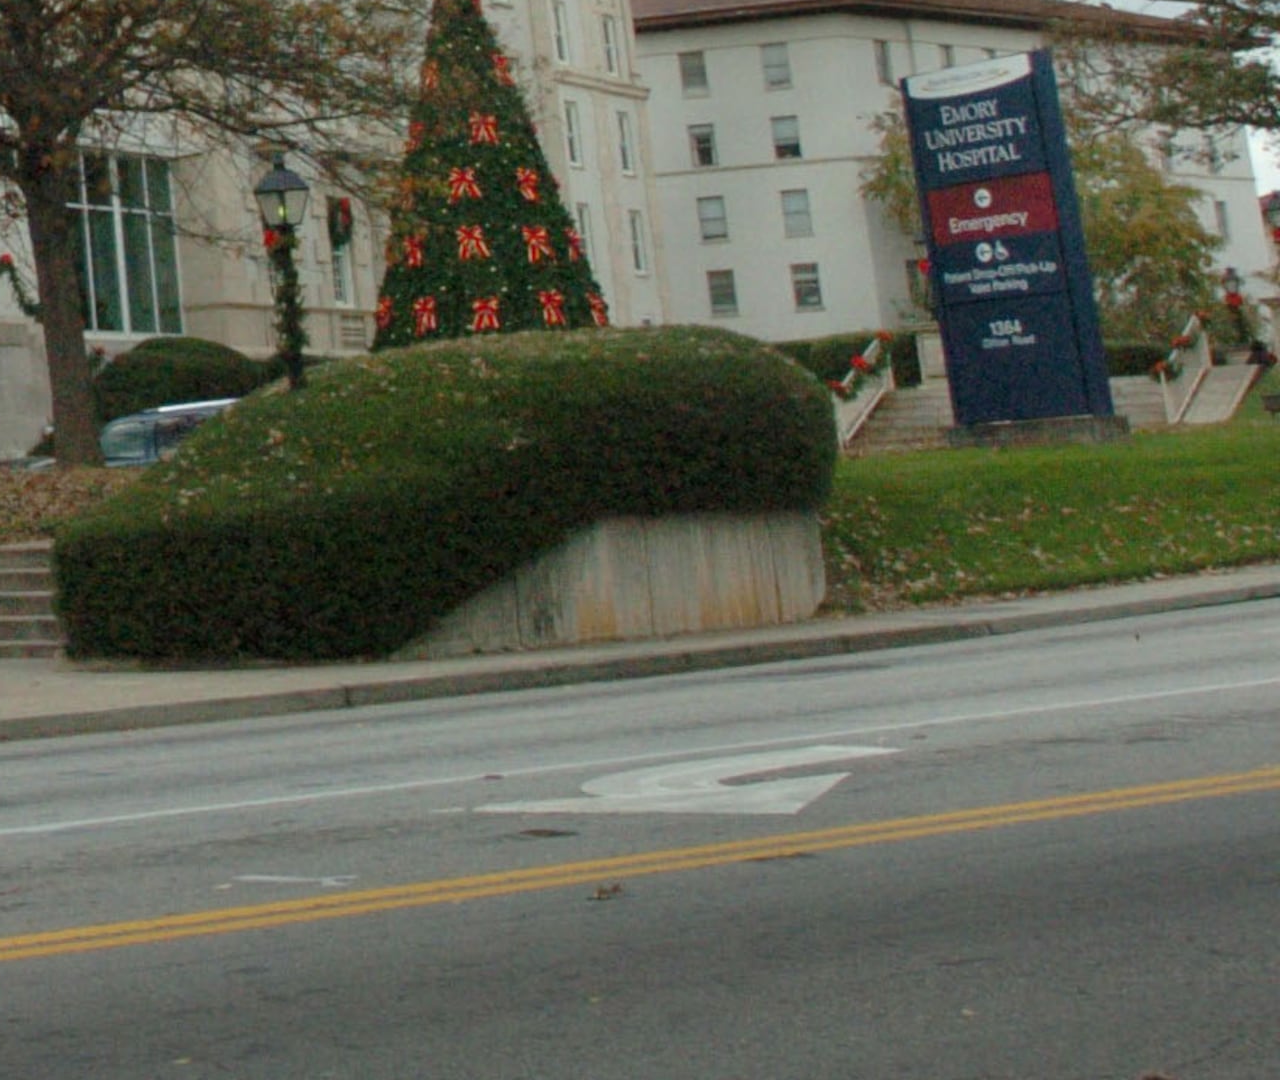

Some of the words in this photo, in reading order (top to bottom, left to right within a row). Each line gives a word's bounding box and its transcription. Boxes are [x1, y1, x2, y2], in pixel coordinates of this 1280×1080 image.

[940, 98, 999, 126] EMORY
[924, 116, 1028, 151] UNIVERSITY
[938, 142, 1022, 173] HOSPITAL
[948, 211, 1029, 235] Emergency
